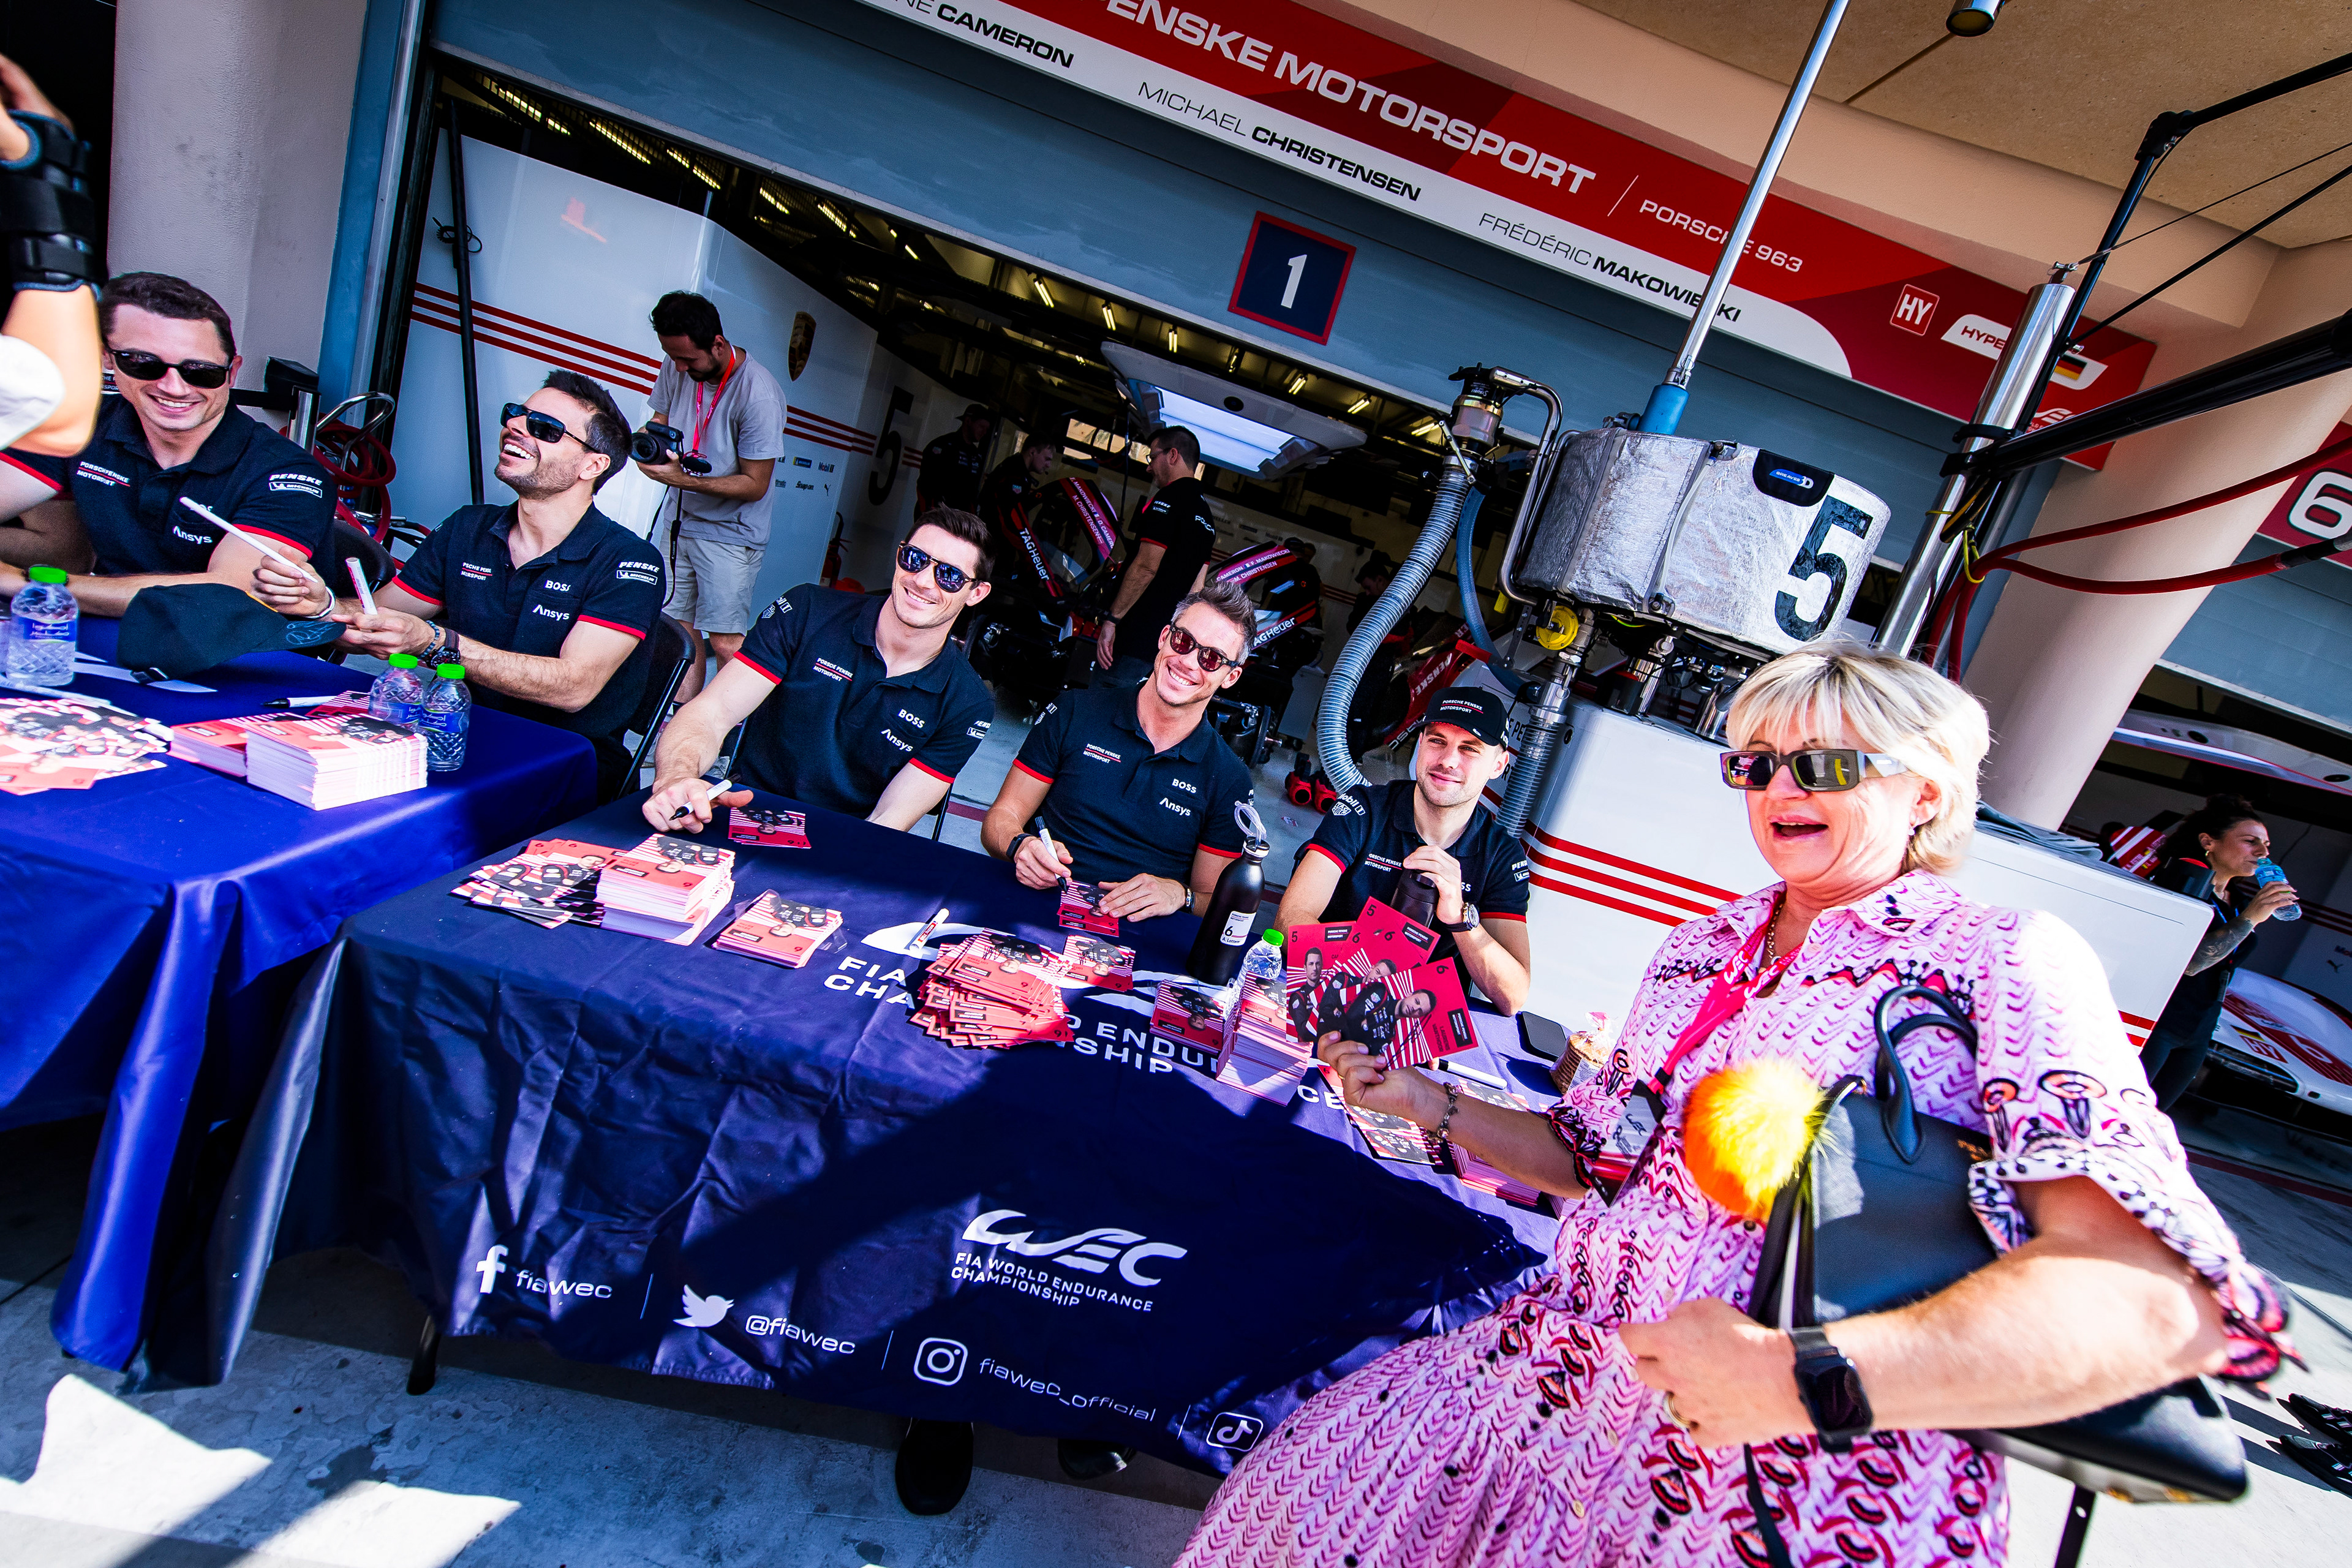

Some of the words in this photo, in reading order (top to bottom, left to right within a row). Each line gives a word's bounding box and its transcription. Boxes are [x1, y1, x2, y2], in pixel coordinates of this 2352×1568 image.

[937, 3, 1074, 69] CAMERON
[1274, 51, 1596, 194] MOTORSPORT
[1138, 81, 1246, 137] MICHAEL
[1252, 126, 1421, 201] CHRISTENSEN
[1639, 199, 1755, 254] PORSCE
[1755, 245, 1803, 272] 963
[1479, 213, 1592, 266] FRÉDÉRIC
[1593, 256, 1741, 322] MAKOWIEKI
[1281, 254, 1307, 309] 1
[1896, 293, 1933, 325] HY
[1961, 325, 2007, 350] HYPE
[868, 385, 914, 506] 5
[269, 473, 323, 486] PENSKE
[1776, 471, 1801, 482] GREAVES
[1073, 481, 1096, 513] MAKOWIECKI
[1101, 526, 1115, 549] CAMERO
[2288, 468, 2352, 540] 6
[1076, 501, 1101, 539] CHRISTENSEN
[172, 526, 213, 545] Ansys
[618, 561, 660, 573] PENSKE
[1256, 548, 1291, 564] MAKOWIECKI
[1240, 560, 1278, 579] CHRISTENSEN
[1774, 496, 1873, 642] 5
[532, 604, 570, 622] Ansys
[1253, 617, 1295, 646] AGHeuer
[1464, 701, 1483, 710] PENSKE
[898, 709, 925, 728] BOSS
[880, 728, 914, 753] Ansys
[1086, 743, 1106, 754] PORSCHE
[1104, 750, 1121, 760] PENSKE
[1083, 750, 1111, 764] MOTORSPORT
[1172, 778, 1197, 794] BOSS
[1159, 797, 1191, 816] Ansys
[1511, 860, 1528, 871] PENS
[1461, 882, 1472, 892] SS
[1366, 904, 1377, 917] 5
[1224, 925, 1233, 937] 6
[1291, 931, 1298, 943] 5
[1352, 932, 1361, 943] 6
[1384, 931, 1396, 941] 6
[837, 956, 907, 984] FIA
[1436, 965, 1449, 974] 6
[1723, 950, 1749, 985] WEC
[1744, 965, 1778, 1000] WEC
[951, 1266, 1080, 1306] CHAMPIONSHIP
[955, 1252, 982, 1268] FIA
[987, 1257, 1048, 1284] WORLD
[1052, 1276, 1153, 1312] ENDURANCE
[516, 1268, 612, 1299] fiawec
[745, 1314, 856, 1354] @fiawec
[979, 1357, 1156, 1421] fiawec_official
